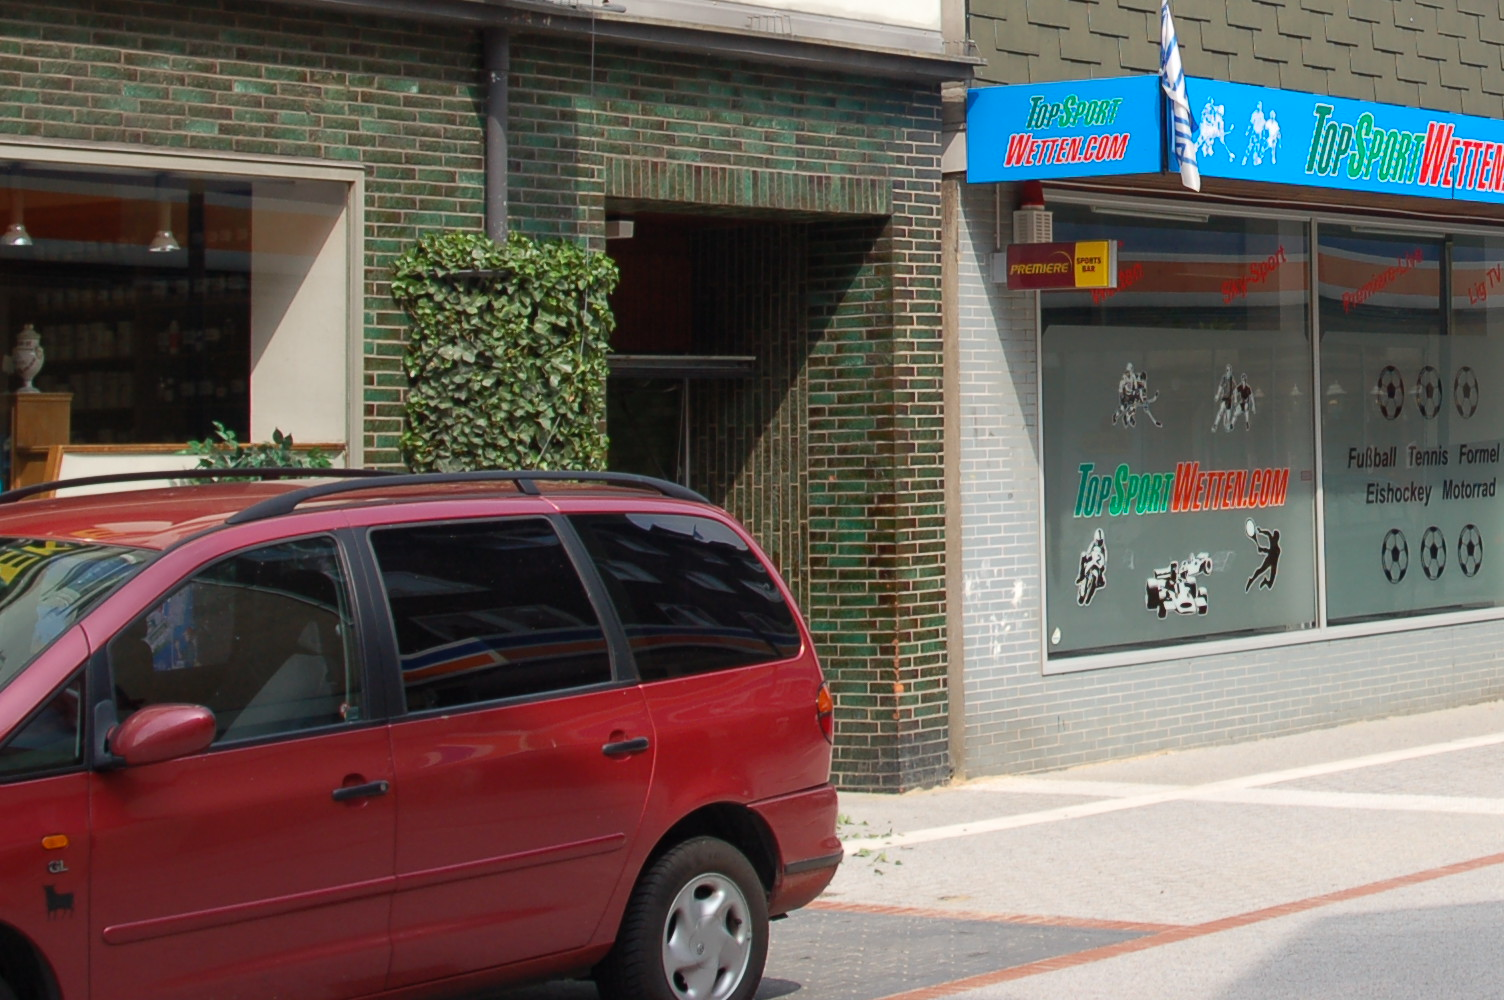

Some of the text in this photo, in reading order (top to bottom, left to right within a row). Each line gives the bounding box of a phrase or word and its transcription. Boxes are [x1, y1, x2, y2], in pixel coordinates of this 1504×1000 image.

[1009, 256, 1101, 276] PREMIERE SPORTS
[1082, 265, 1096, 273] BAR
[1468, 263, 1502, 305] Lig TV
[1348, 447, 1397, 468] Fußball
[1408, 445, 1448, 467] Tennis
[1459, 443, 1500, 465] Formel
[1366, 477, 1496, 506] Eishockey Motorrad
[48, 860, 69, 873] GL
